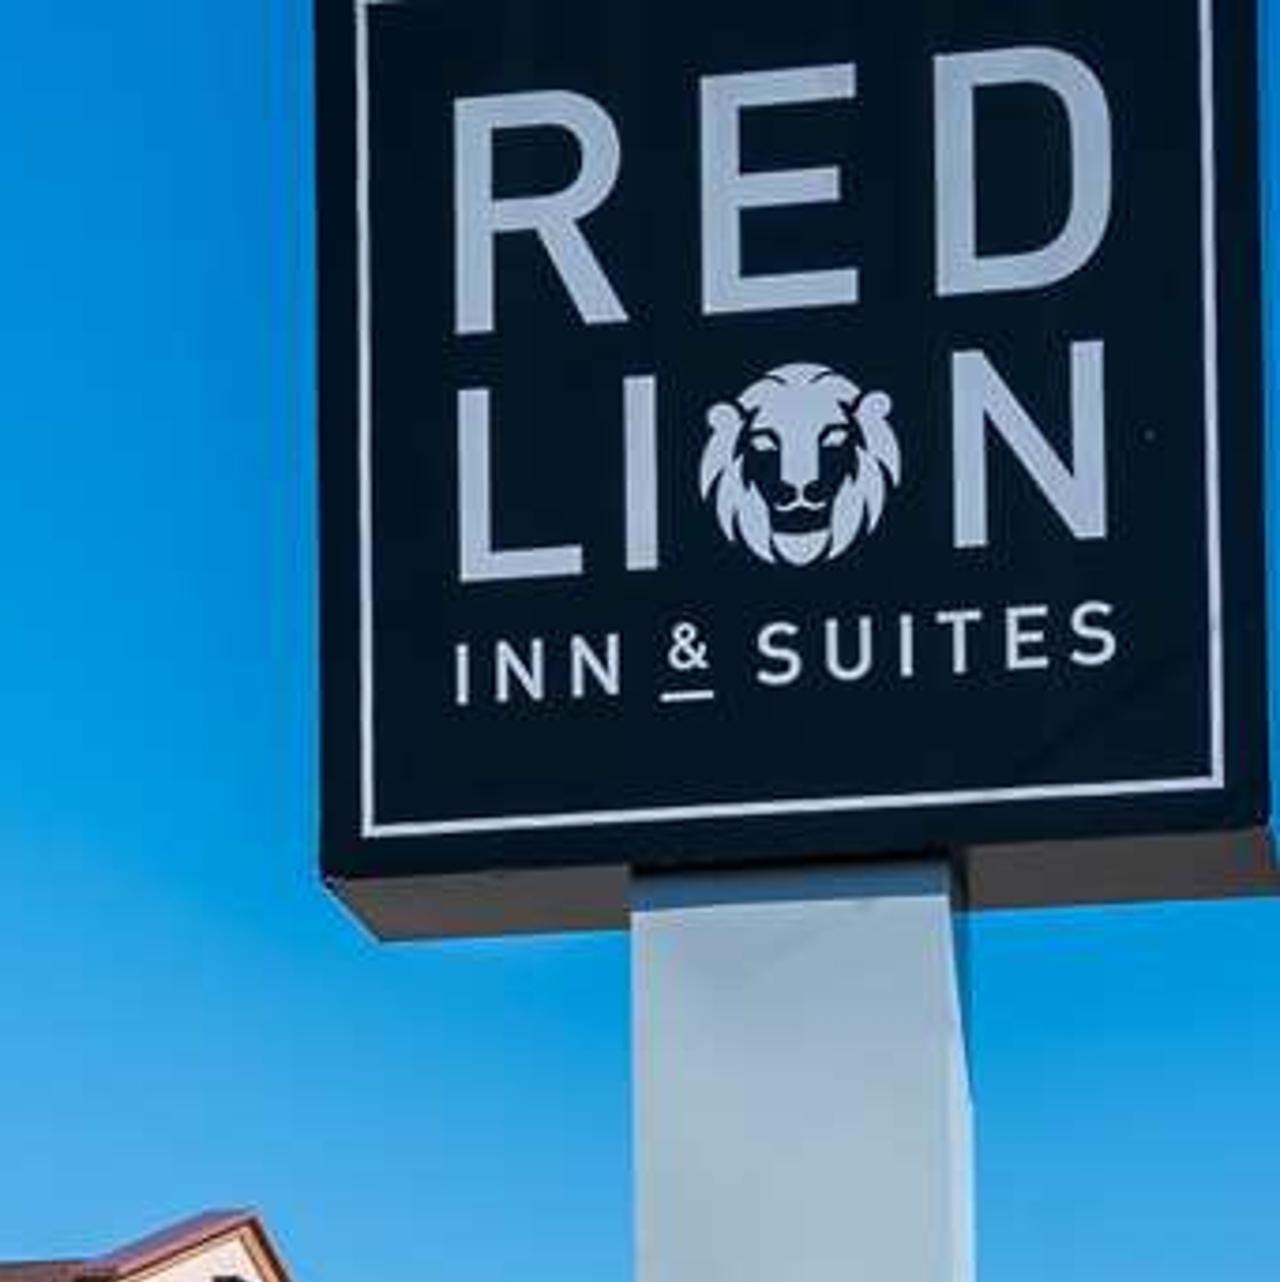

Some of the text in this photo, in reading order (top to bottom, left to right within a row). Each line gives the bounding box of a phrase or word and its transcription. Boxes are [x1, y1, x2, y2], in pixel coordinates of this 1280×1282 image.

[452, 45, 1113, 335] RED
[457, 340, 1107, 583] LION
[455, 600, 1117, 706] INN & SUITES
